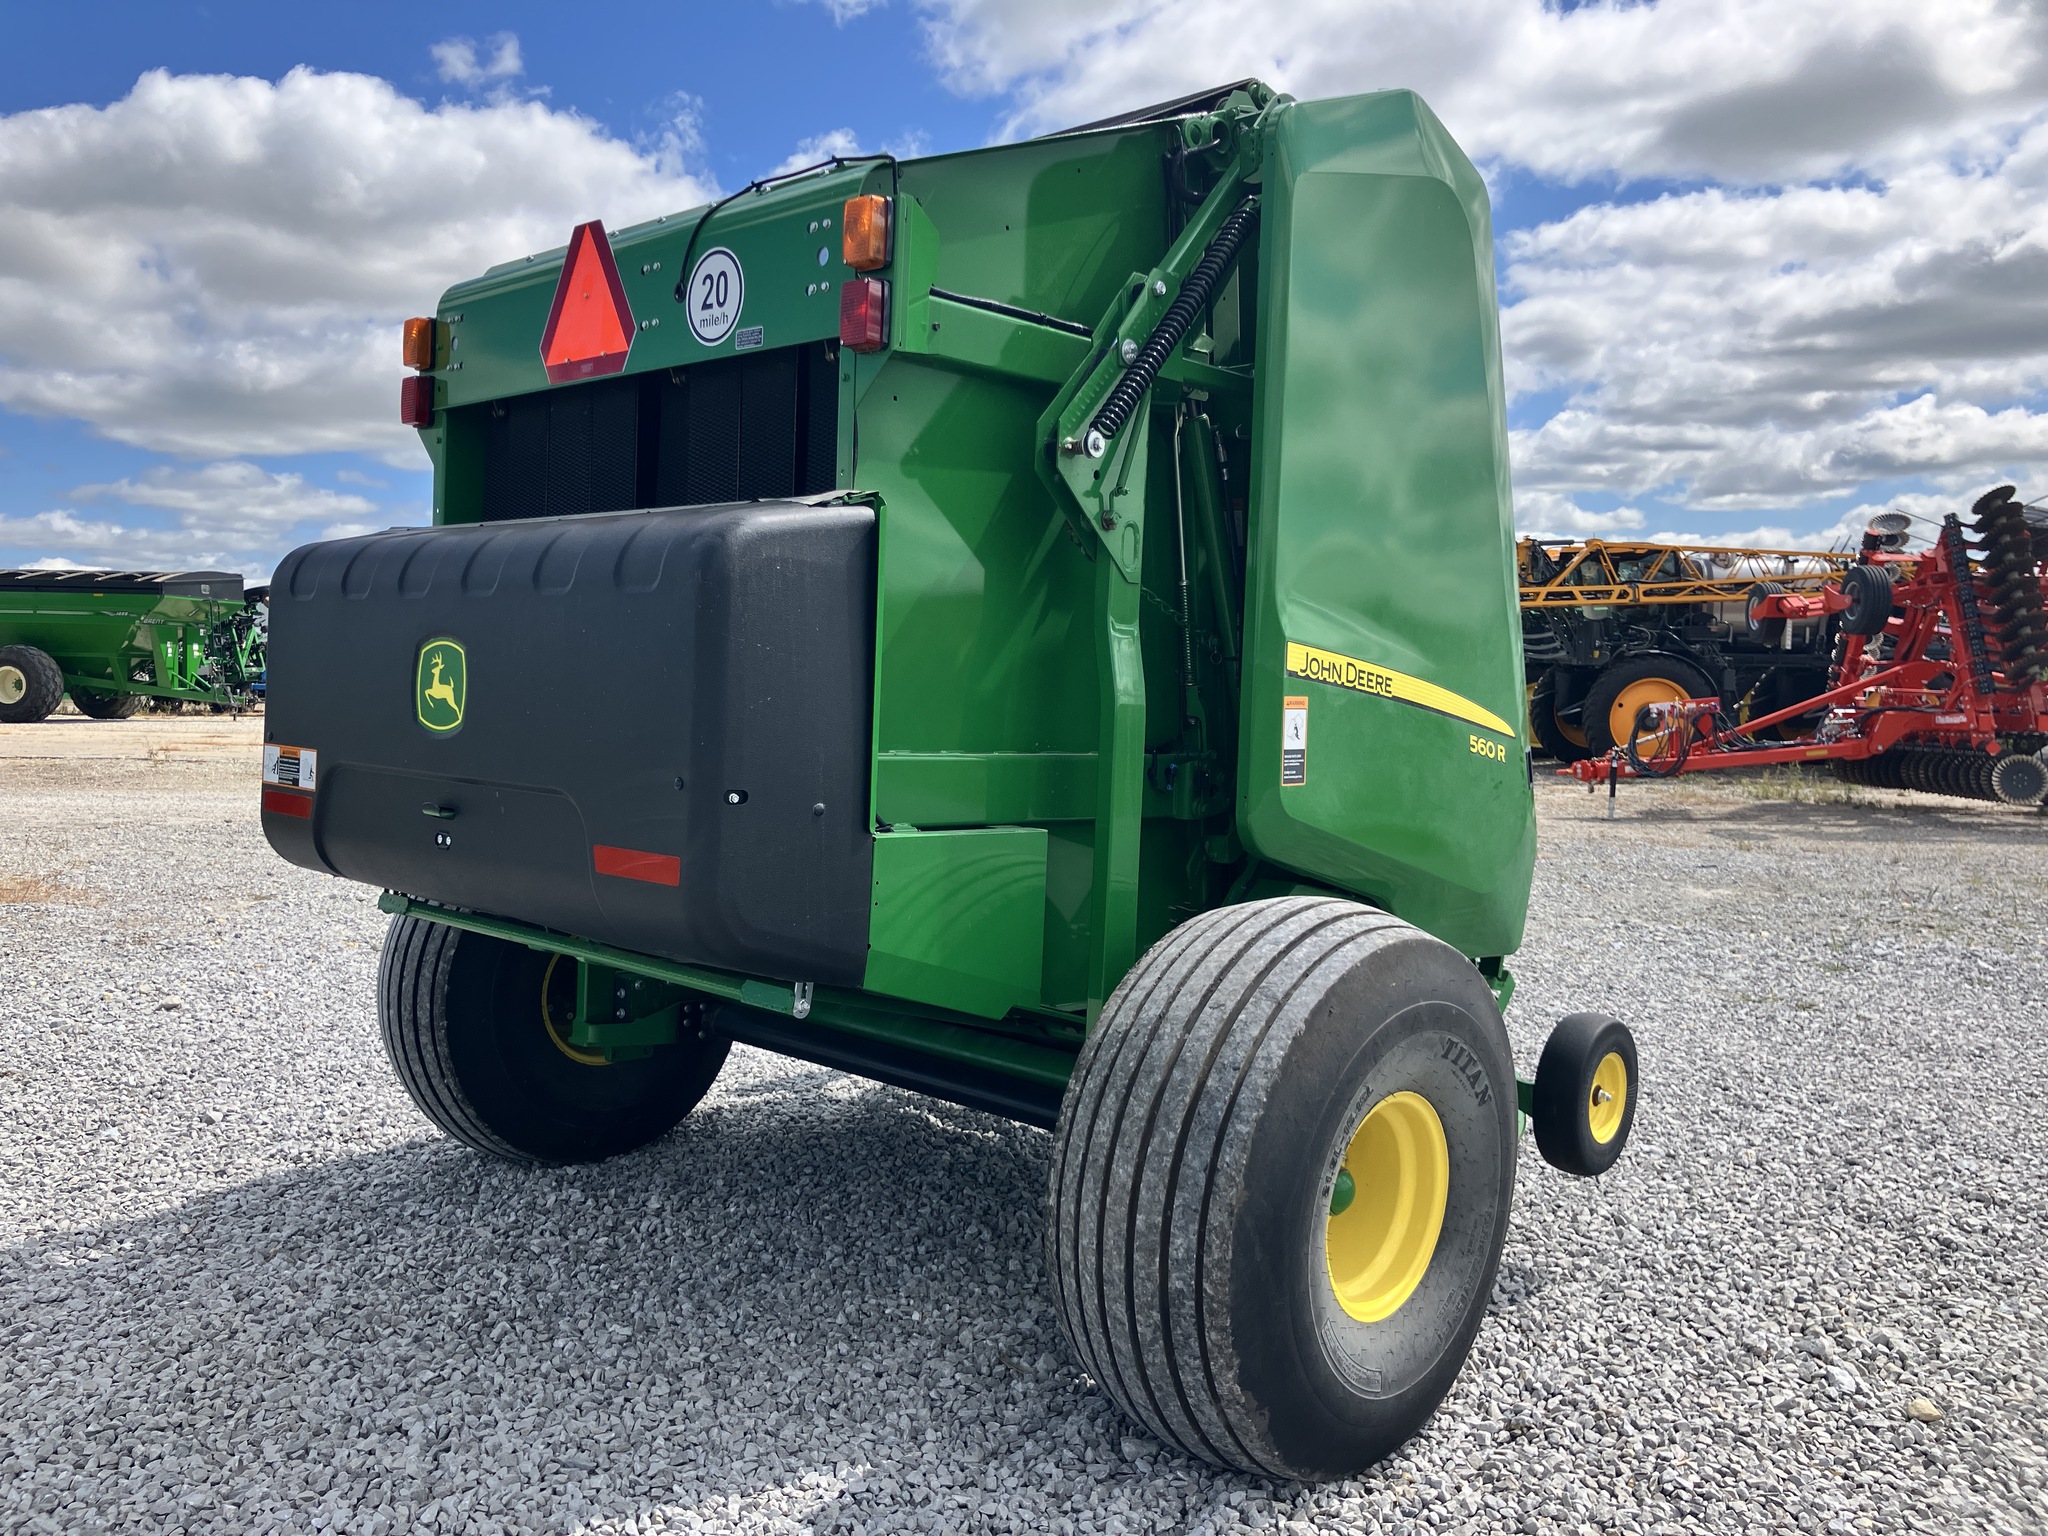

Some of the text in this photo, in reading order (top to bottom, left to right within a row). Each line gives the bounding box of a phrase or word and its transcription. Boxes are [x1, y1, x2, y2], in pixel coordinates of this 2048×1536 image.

[701, 270, 728, 311] 20
[699, 312, 729, 328] mile/h
[1299, 652, 1393, 694] JOHN DEERE
[1469, 734, 1506, 764] 560 R
[1441, 1037, 1492, 1107] TITAN
